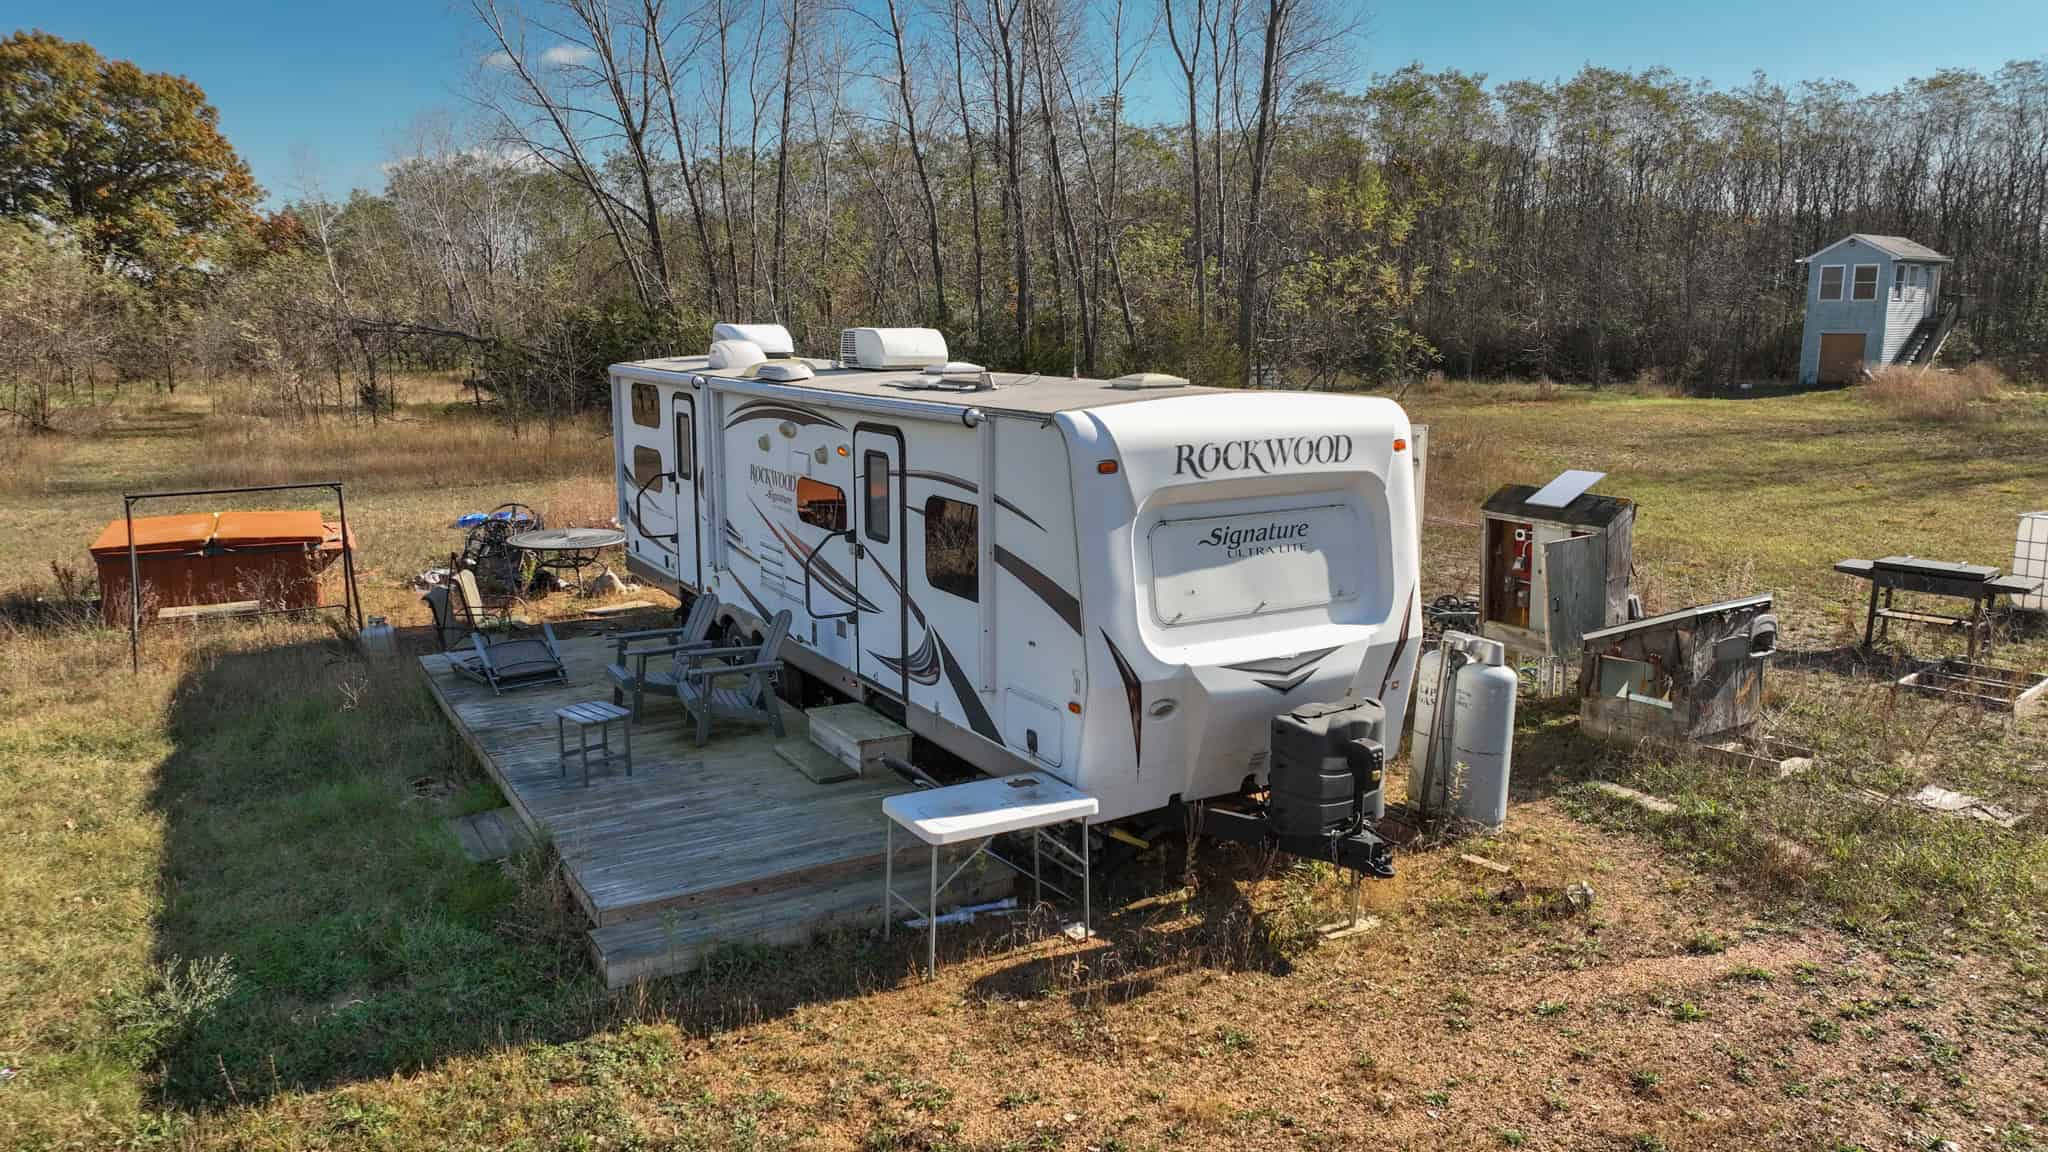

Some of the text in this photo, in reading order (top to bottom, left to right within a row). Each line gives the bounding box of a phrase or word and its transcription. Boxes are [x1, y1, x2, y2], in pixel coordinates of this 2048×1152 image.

[1174, 433, 1353, 479] ROCKWOOD
[750, 463, 796, 492] ROCKWOOD
[1198, 522, 1309, 550] Signature
[1226, 545, 1275, 559] ULTRA
